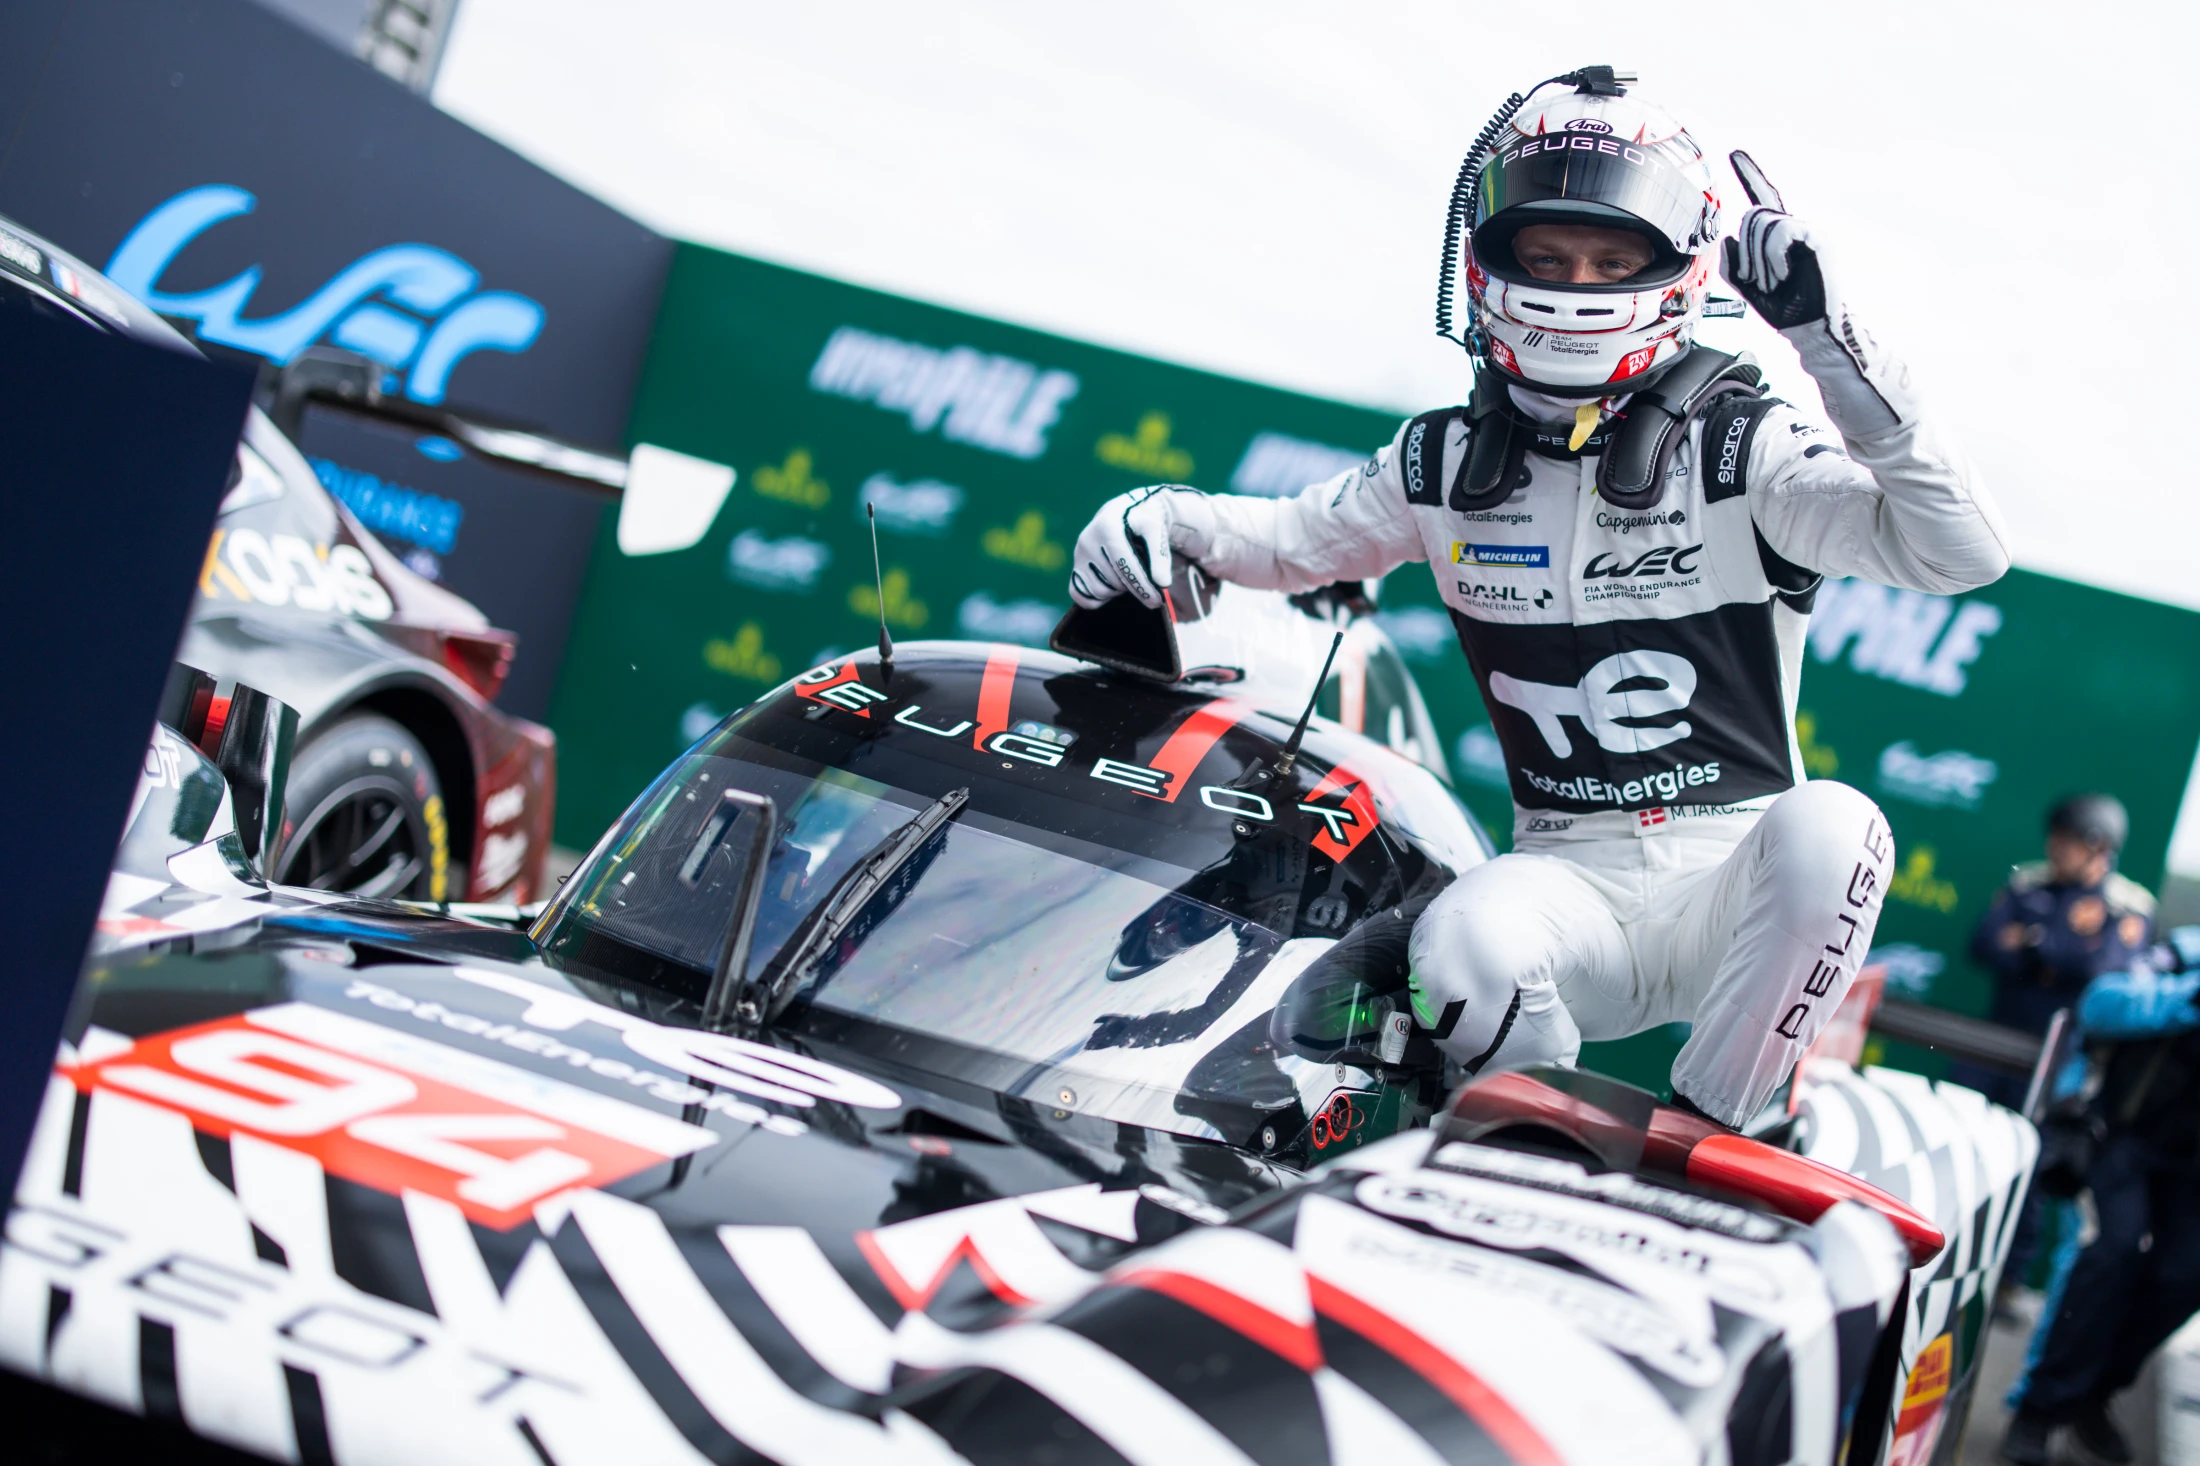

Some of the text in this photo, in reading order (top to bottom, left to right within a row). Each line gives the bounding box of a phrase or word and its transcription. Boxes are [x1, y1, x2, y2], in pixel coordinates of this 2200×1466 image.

[1567, 119, 1608, 132] Arai
[1501, 136, 1665, 176] PEUGEOT
[1550, 340, 1600, 349] PEUGEOT
[1550, 345, 1600, 356] TotalEnergies
[1408, 422, 1427, 493] sparco
[1717, 417, 1748, 484] sparco
[1463, 511, 1533, 526] TotalEnergies
[1596, 511, 1668, 535] Capgemini
[1478, 552, 1542, 563] MICHELIN
[1583, 543, 1703, 579] WEC
[1116, 557, 1151, 600] sparco
[1584, 577, 1701, 594] FIA WORLD ENDURANCE
[1457, 581, 1528, 601] DAHL
[1585, 591, 1661, 602] CHAMPIONSHIP
[808, 666, 1352, 841] PEUGEOT
[1521, 761, 1721, 805] TotalEnergies
